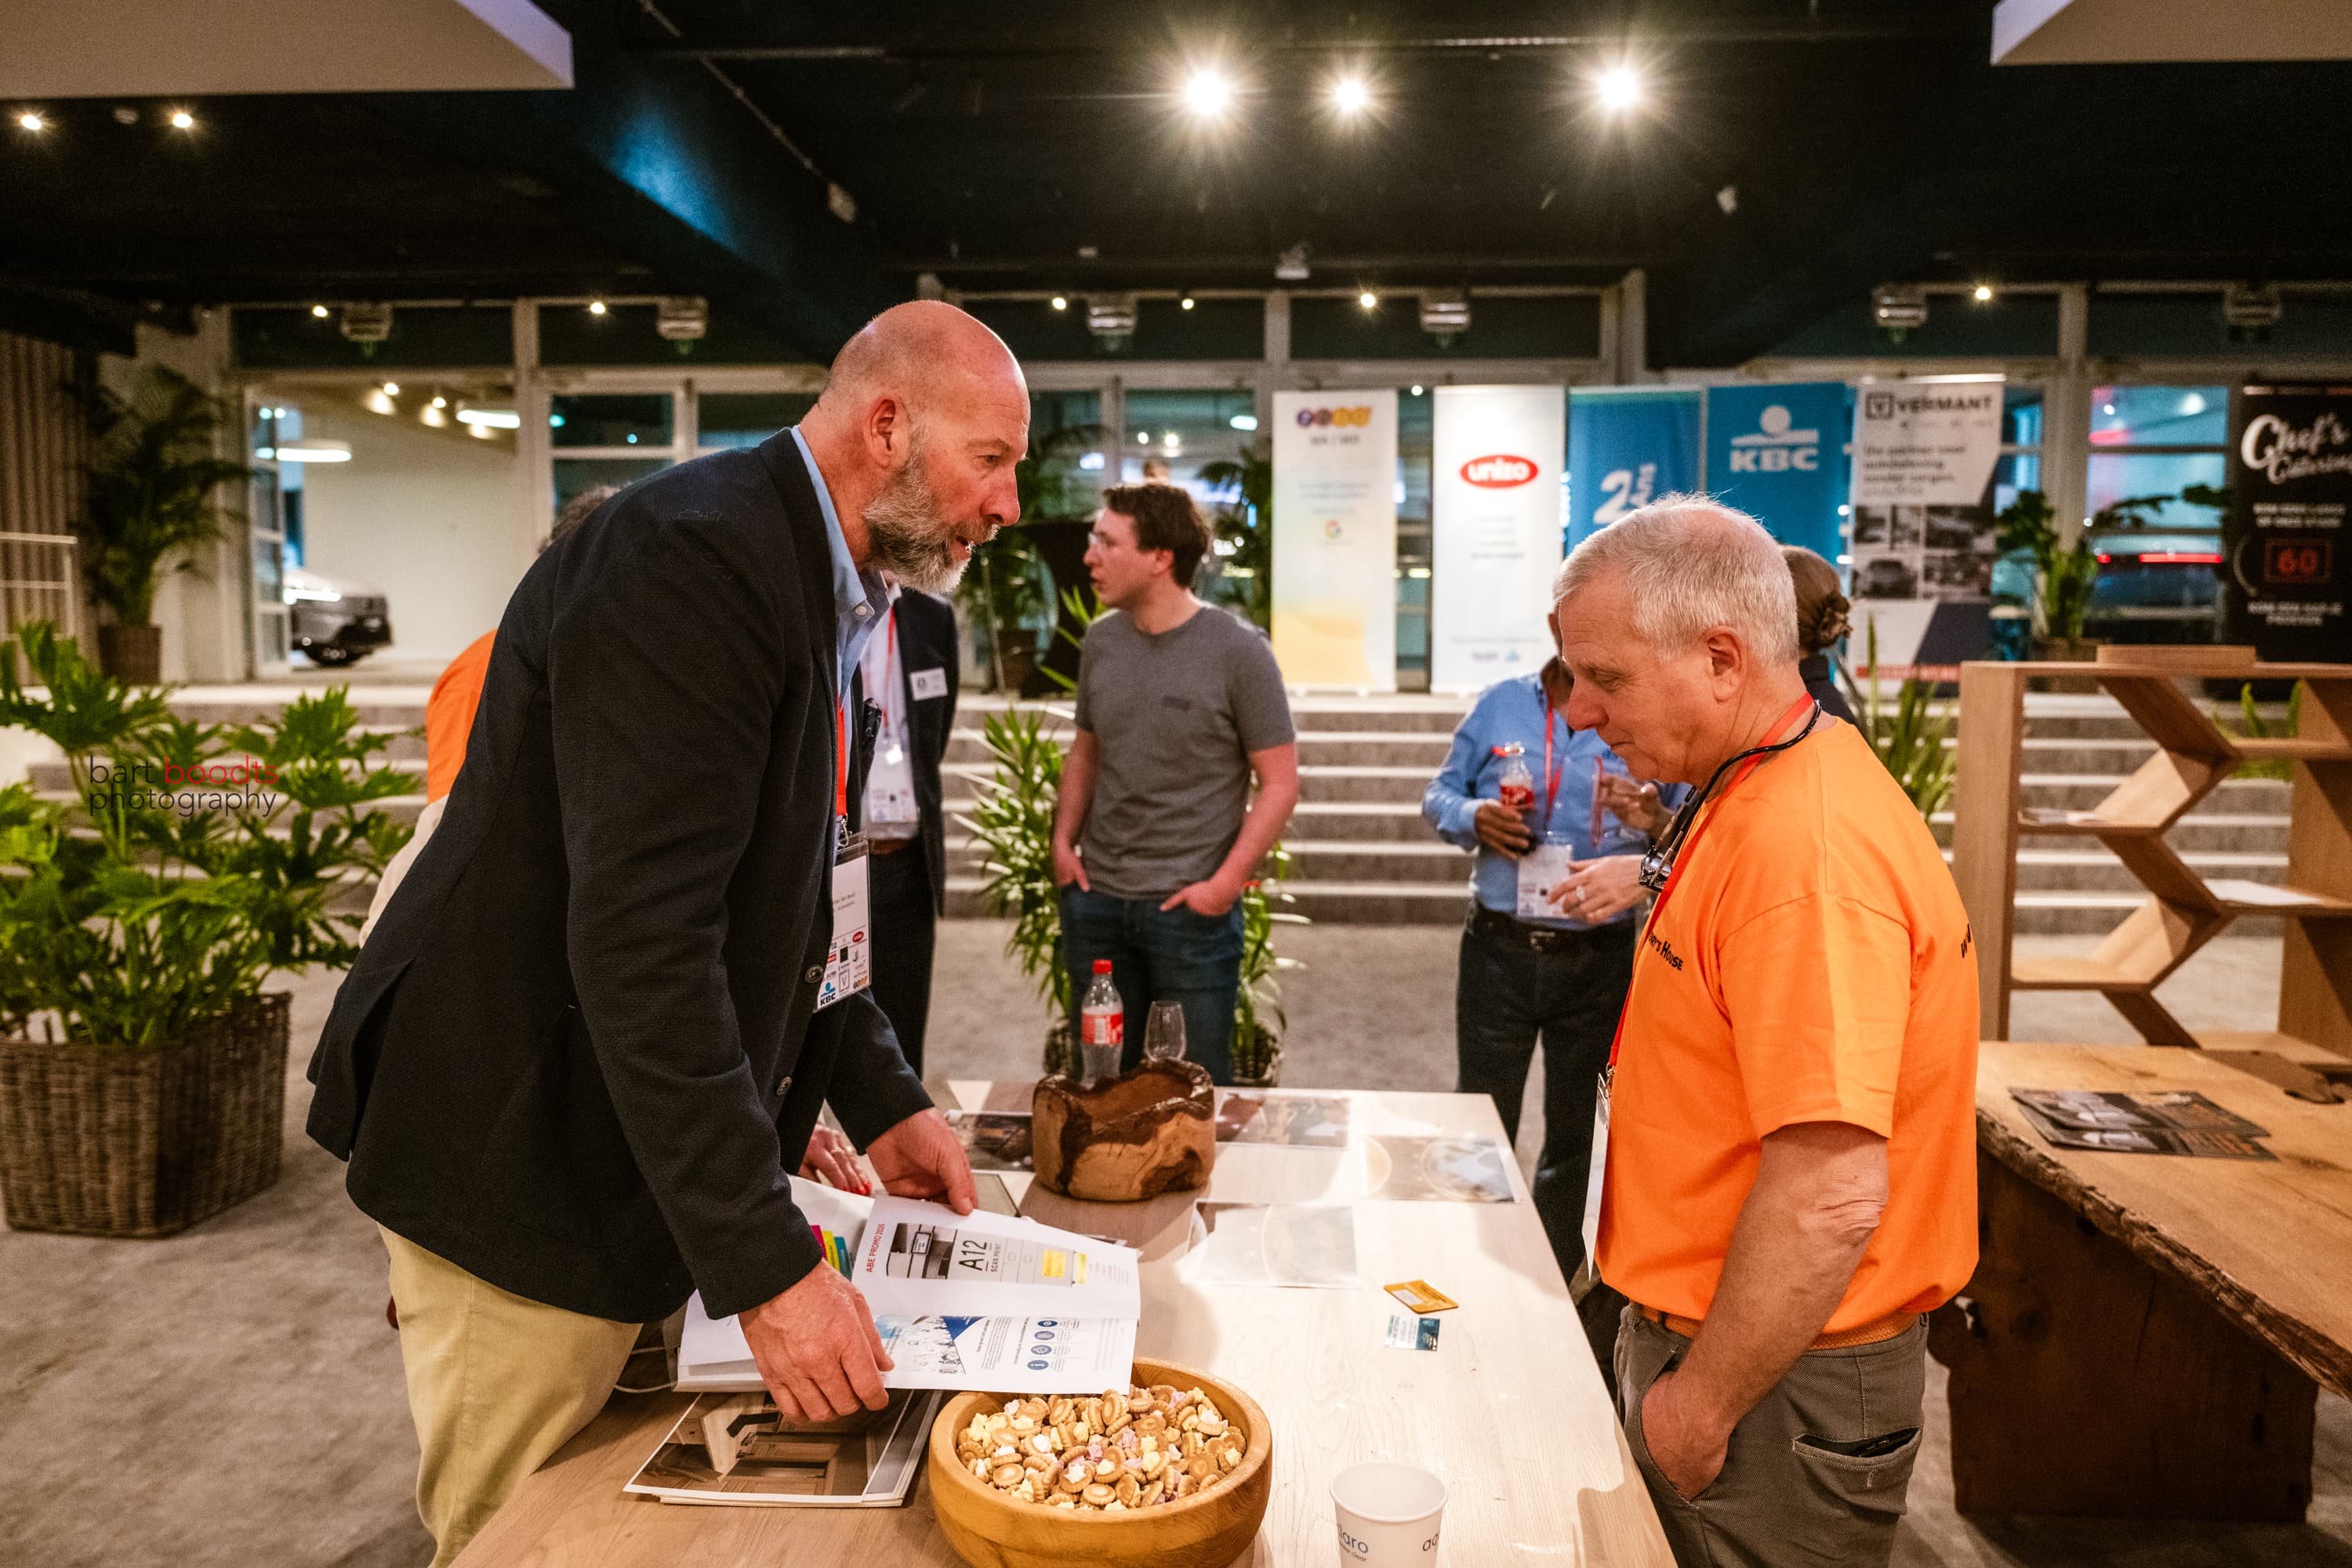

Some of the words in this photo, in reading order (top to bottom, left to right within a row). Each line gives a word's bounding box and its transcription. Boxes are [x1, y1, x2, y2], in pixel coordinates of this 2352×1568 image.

[1897, 396, 1992, 413] VERMANT
[1730, 448, 1818, 472] KBC
[820, 993, 836, 1007] KBC
[869, 1236, 881, 1256] PROMO
[958, 1240, 987, 1271] A12
[865, 1258, 876, 1272] ABE
[990, 1258, 999, 1272] SCAN
